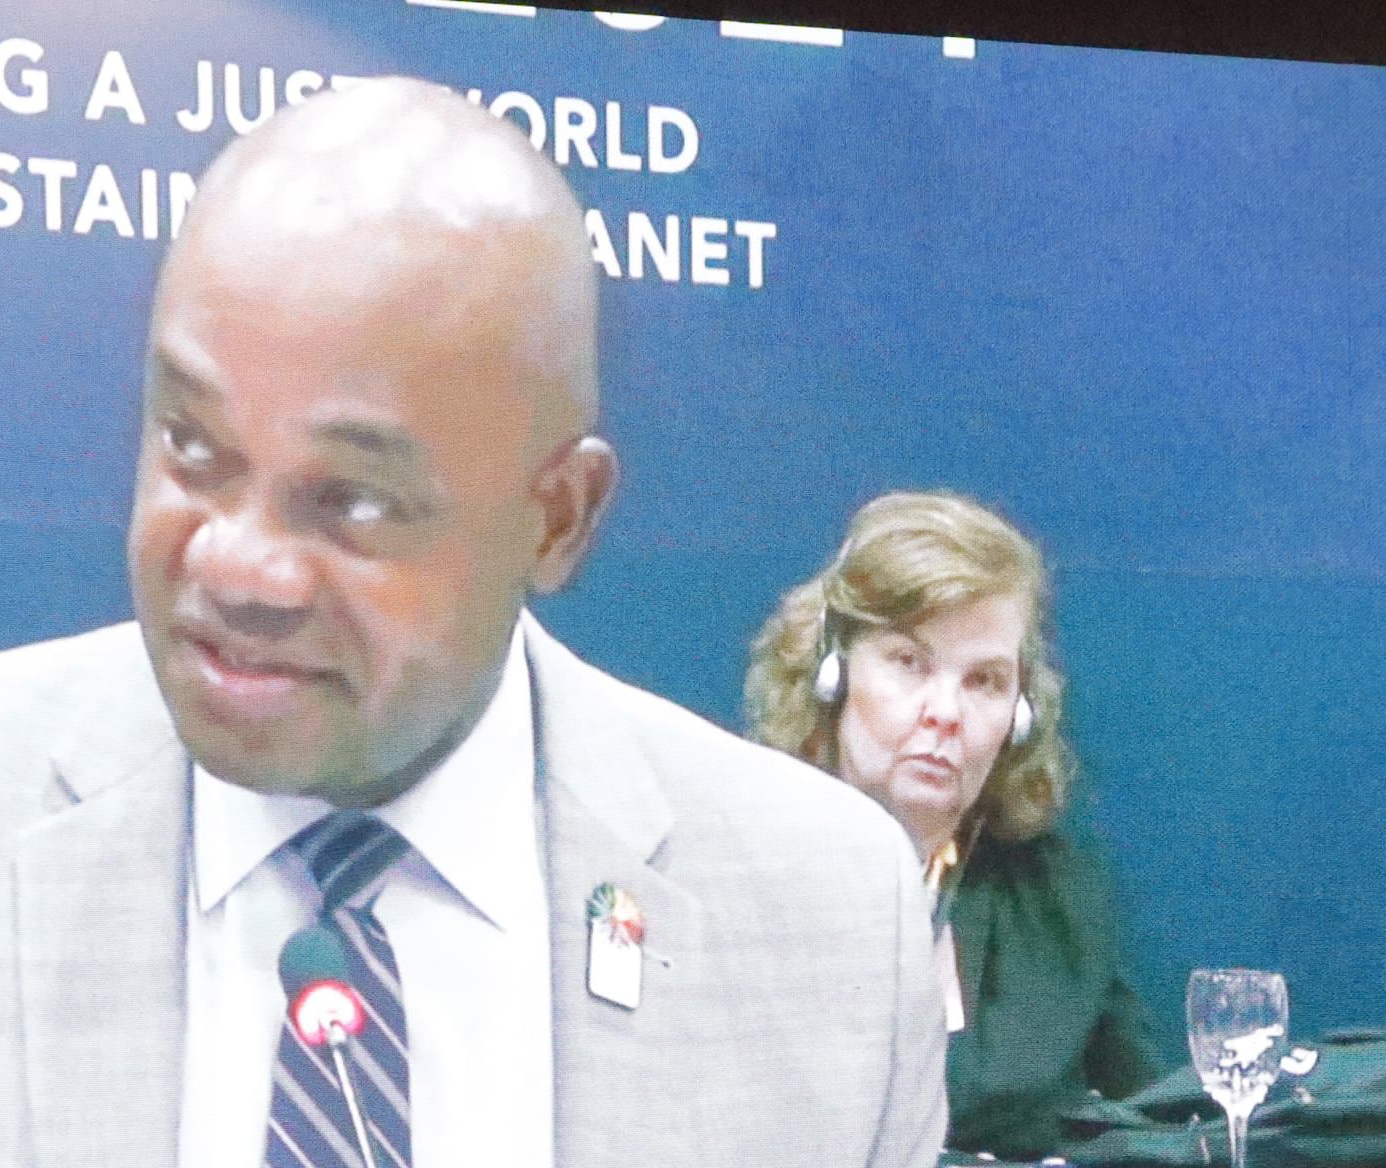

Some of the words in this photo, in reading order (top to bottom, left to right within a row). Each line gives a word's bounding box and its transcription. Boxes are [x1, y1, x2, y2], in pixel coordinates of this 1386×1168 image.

[84, 50, 147, 125] A
[443, 87, 700, 174] ORLD
[584, 207, 778, 289] ANET
